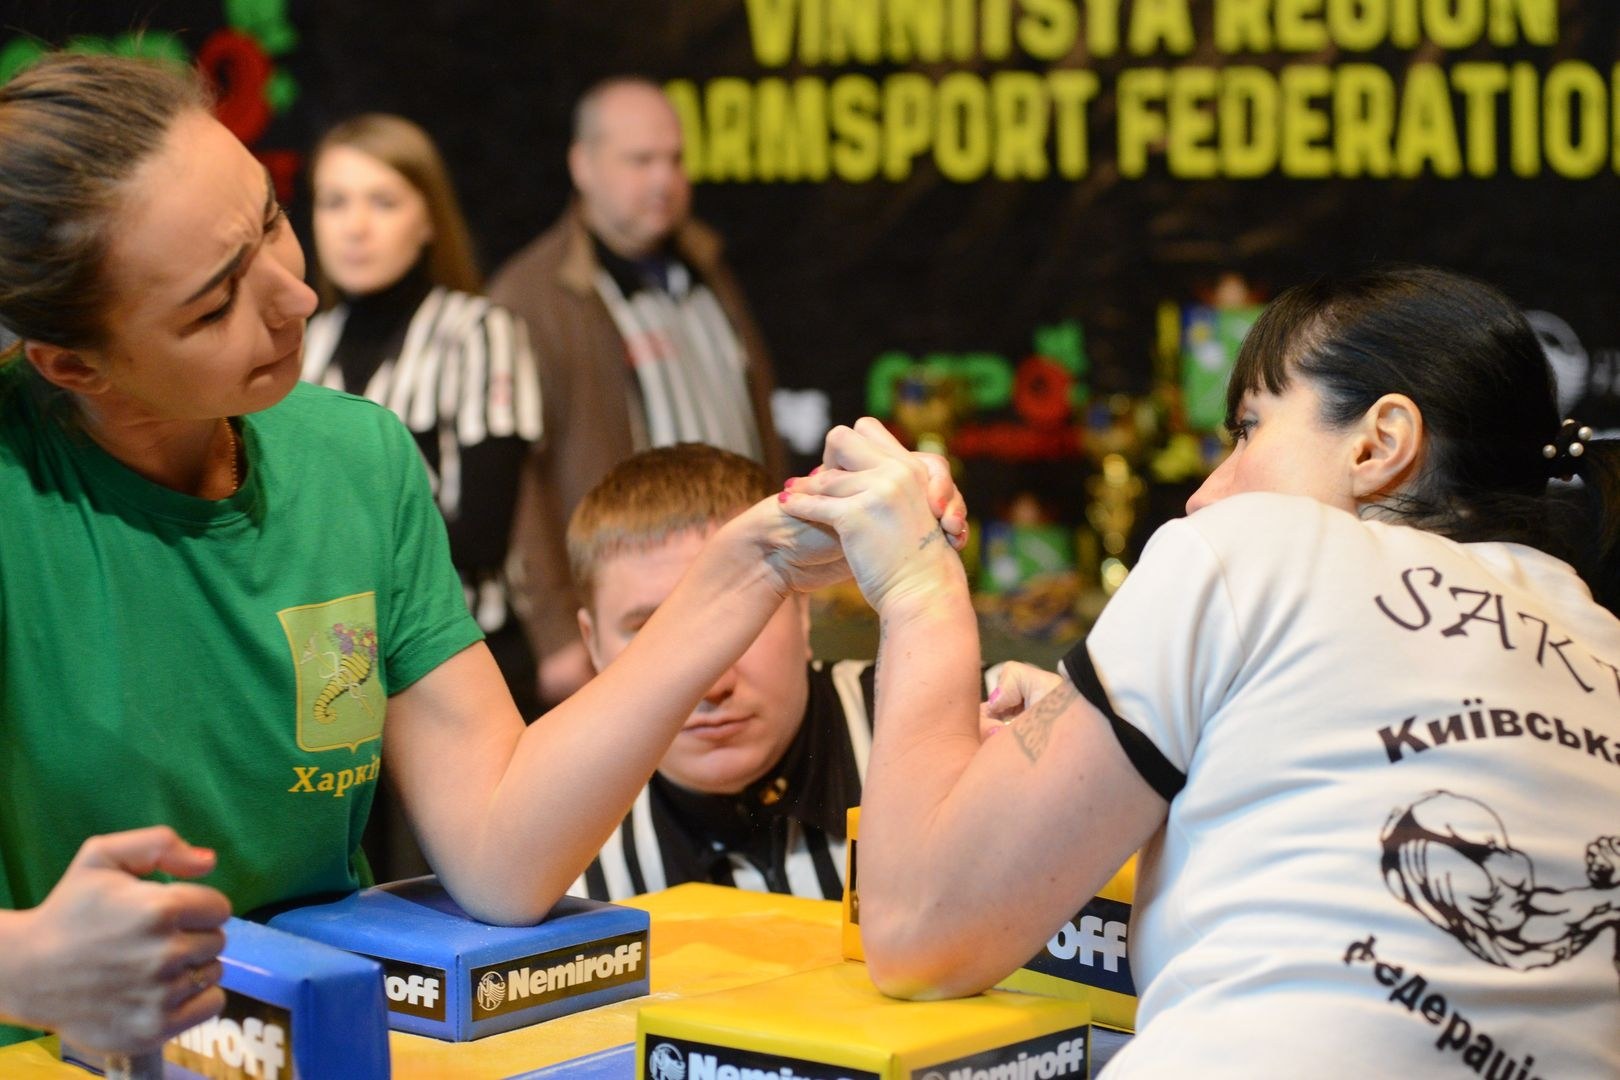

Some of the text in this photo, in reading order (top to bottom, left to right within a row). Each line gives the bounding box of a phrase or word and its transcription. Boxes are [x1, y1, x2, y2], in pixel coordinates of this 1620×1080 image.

[1116, 60, 1620, 180] FEDERATIO
[288, 754, 381, 798] Харкі
[508, 941, 642, 1002] Nemiroff
